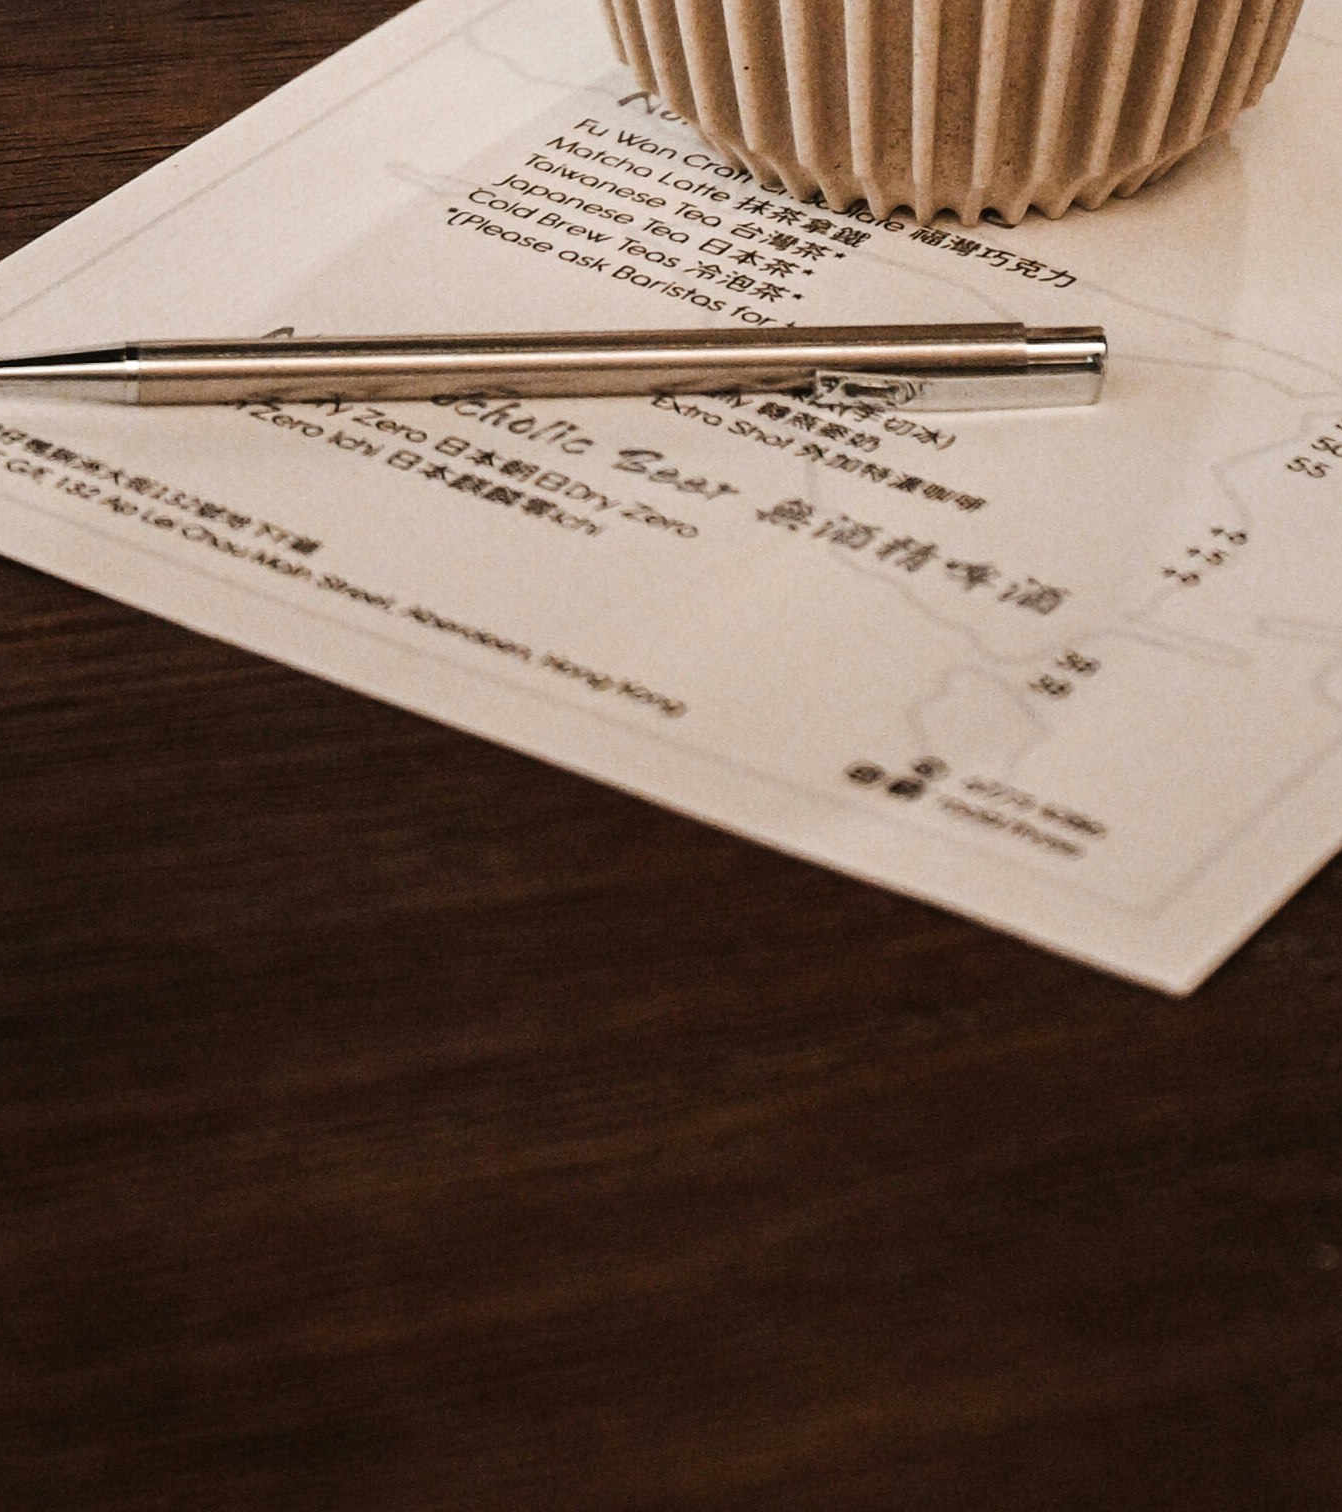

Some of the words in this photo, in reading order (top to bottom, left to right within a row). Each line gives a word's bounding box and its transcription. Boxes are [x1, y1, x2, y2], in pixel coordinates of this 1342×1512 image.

[467, 186, 540, 220] Cold
[536, 212, 613, 244] Brew
[617, 236, 681, 269] Teas
[491, 173, 635, 225] Japanese
[641, 217, 690, 245] Tea
[524, 152, 667, 208] Taiwanese
[674, 201, 722, 228] Tea
[545, 135, 653, 179] Matcha
[657, 171, 731, 203] Latte
[734, 196, 872, 249] 抹茶拿鐵
[573, 117, 610, 138] Fu
[616, 130, 678, 160] Wan
[909, 221, 1078, 289] 福灣巧克力
[557, 249, 611, 273] ask
[610, 264, 727, 312] Baristas
[731, 305, 779, 326] for
[248, 400, 325, 438] Zero
[727, 420, 795, 450] Shot
[351, 409, 428, 444] Zero
[620, 502, 700, 539] Zero
[1285, 455, 1331, 479] 55
